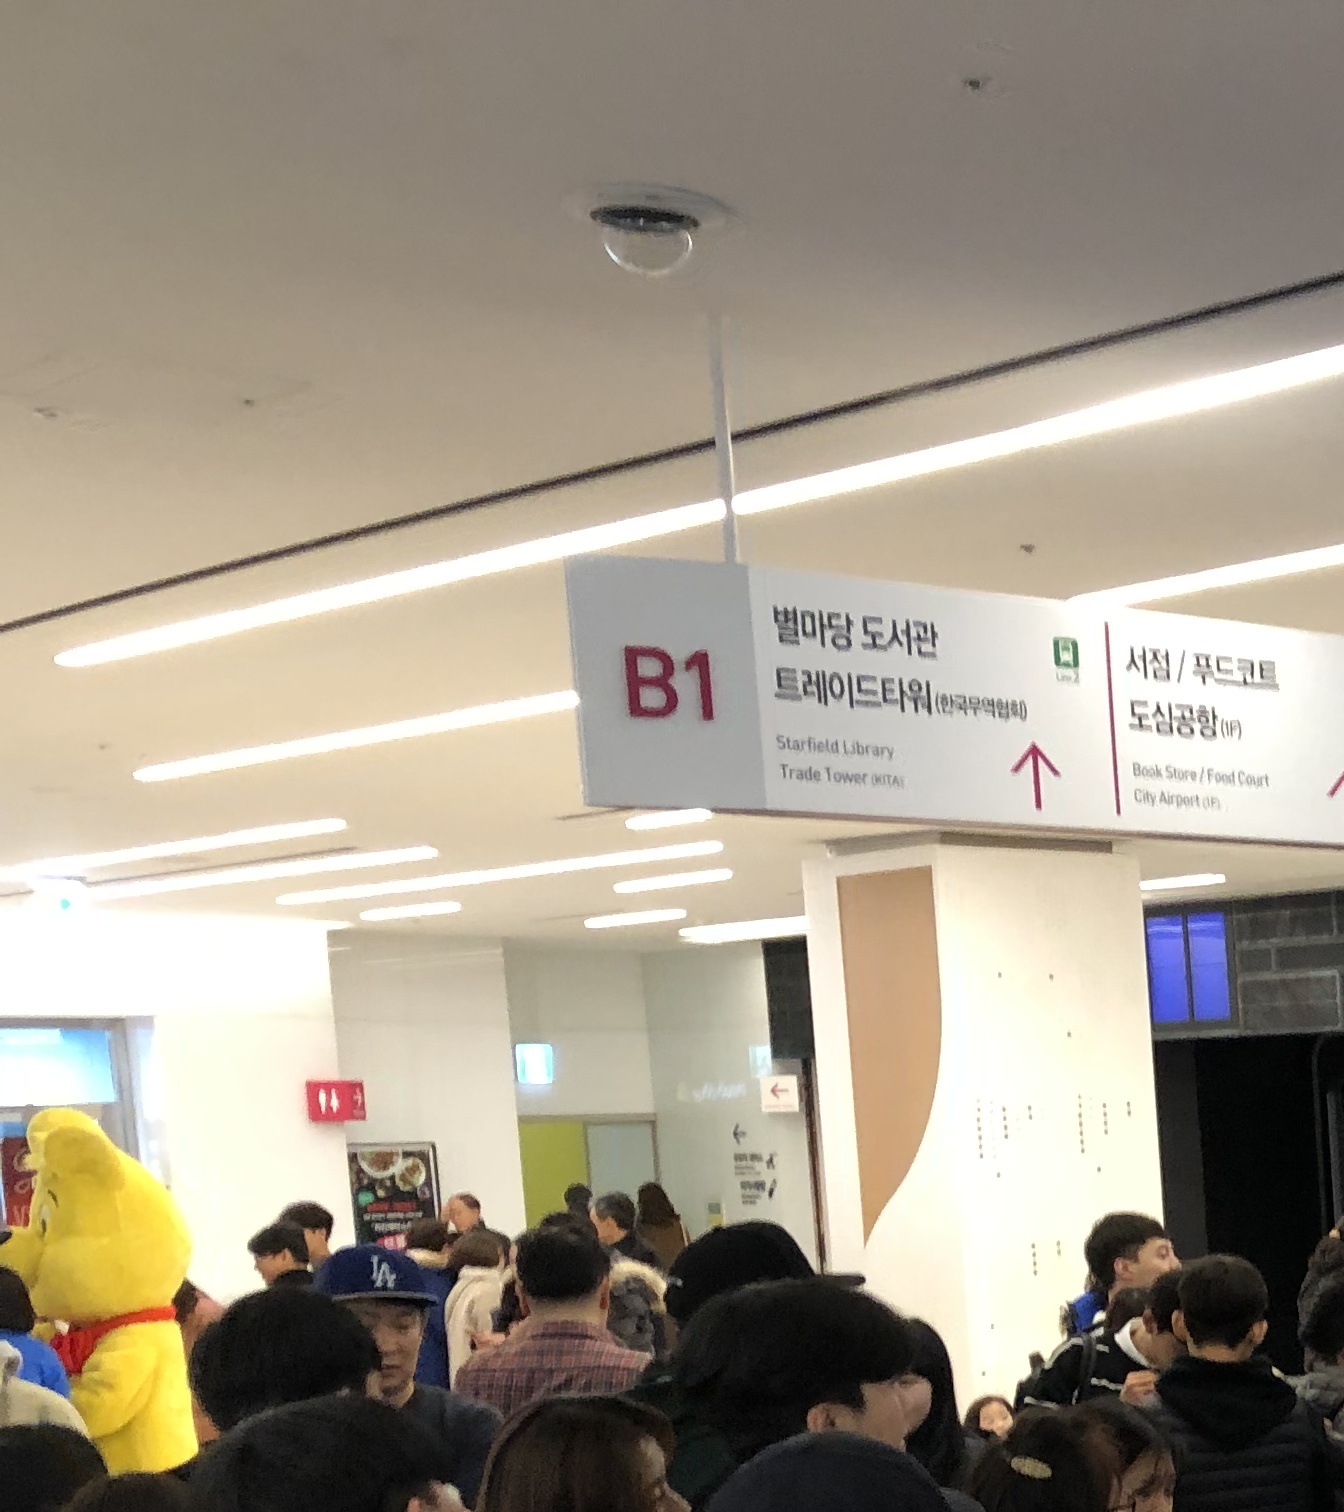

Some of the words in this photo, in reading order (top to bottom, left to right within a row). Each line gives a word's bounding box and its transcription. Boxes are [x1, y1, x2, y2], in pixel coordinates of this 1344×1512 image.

[773, 604, 853, 652] 별마당
[861, 615, 938, 660] 도서관
[625, 645, 714, 720] B1
[1126, 645, 1170, 682] 서점
[1193, 653, 1279, 691] 푸드코트
[774, 667, 932, 715] 트레이드타워
[1129, 699, 1218, 741] 도심공항
[776, 734, 839, 754] Starfield
[843, 740, 894, 760] Library
[780, 763, 821, 781] Trade
[825, 767, 867, 785] Tower
[1132, 761, 1162, 780] Book
[1165, 765, 1197, 782] Store
[1207, 768, 1236, 786] Food
[1238, 770, 1269, 788] Court
[1134, 788, 1156, 807] City
[1160, 790, 1200, 809] Airport
[370, 1254, 397, 1289] LA
